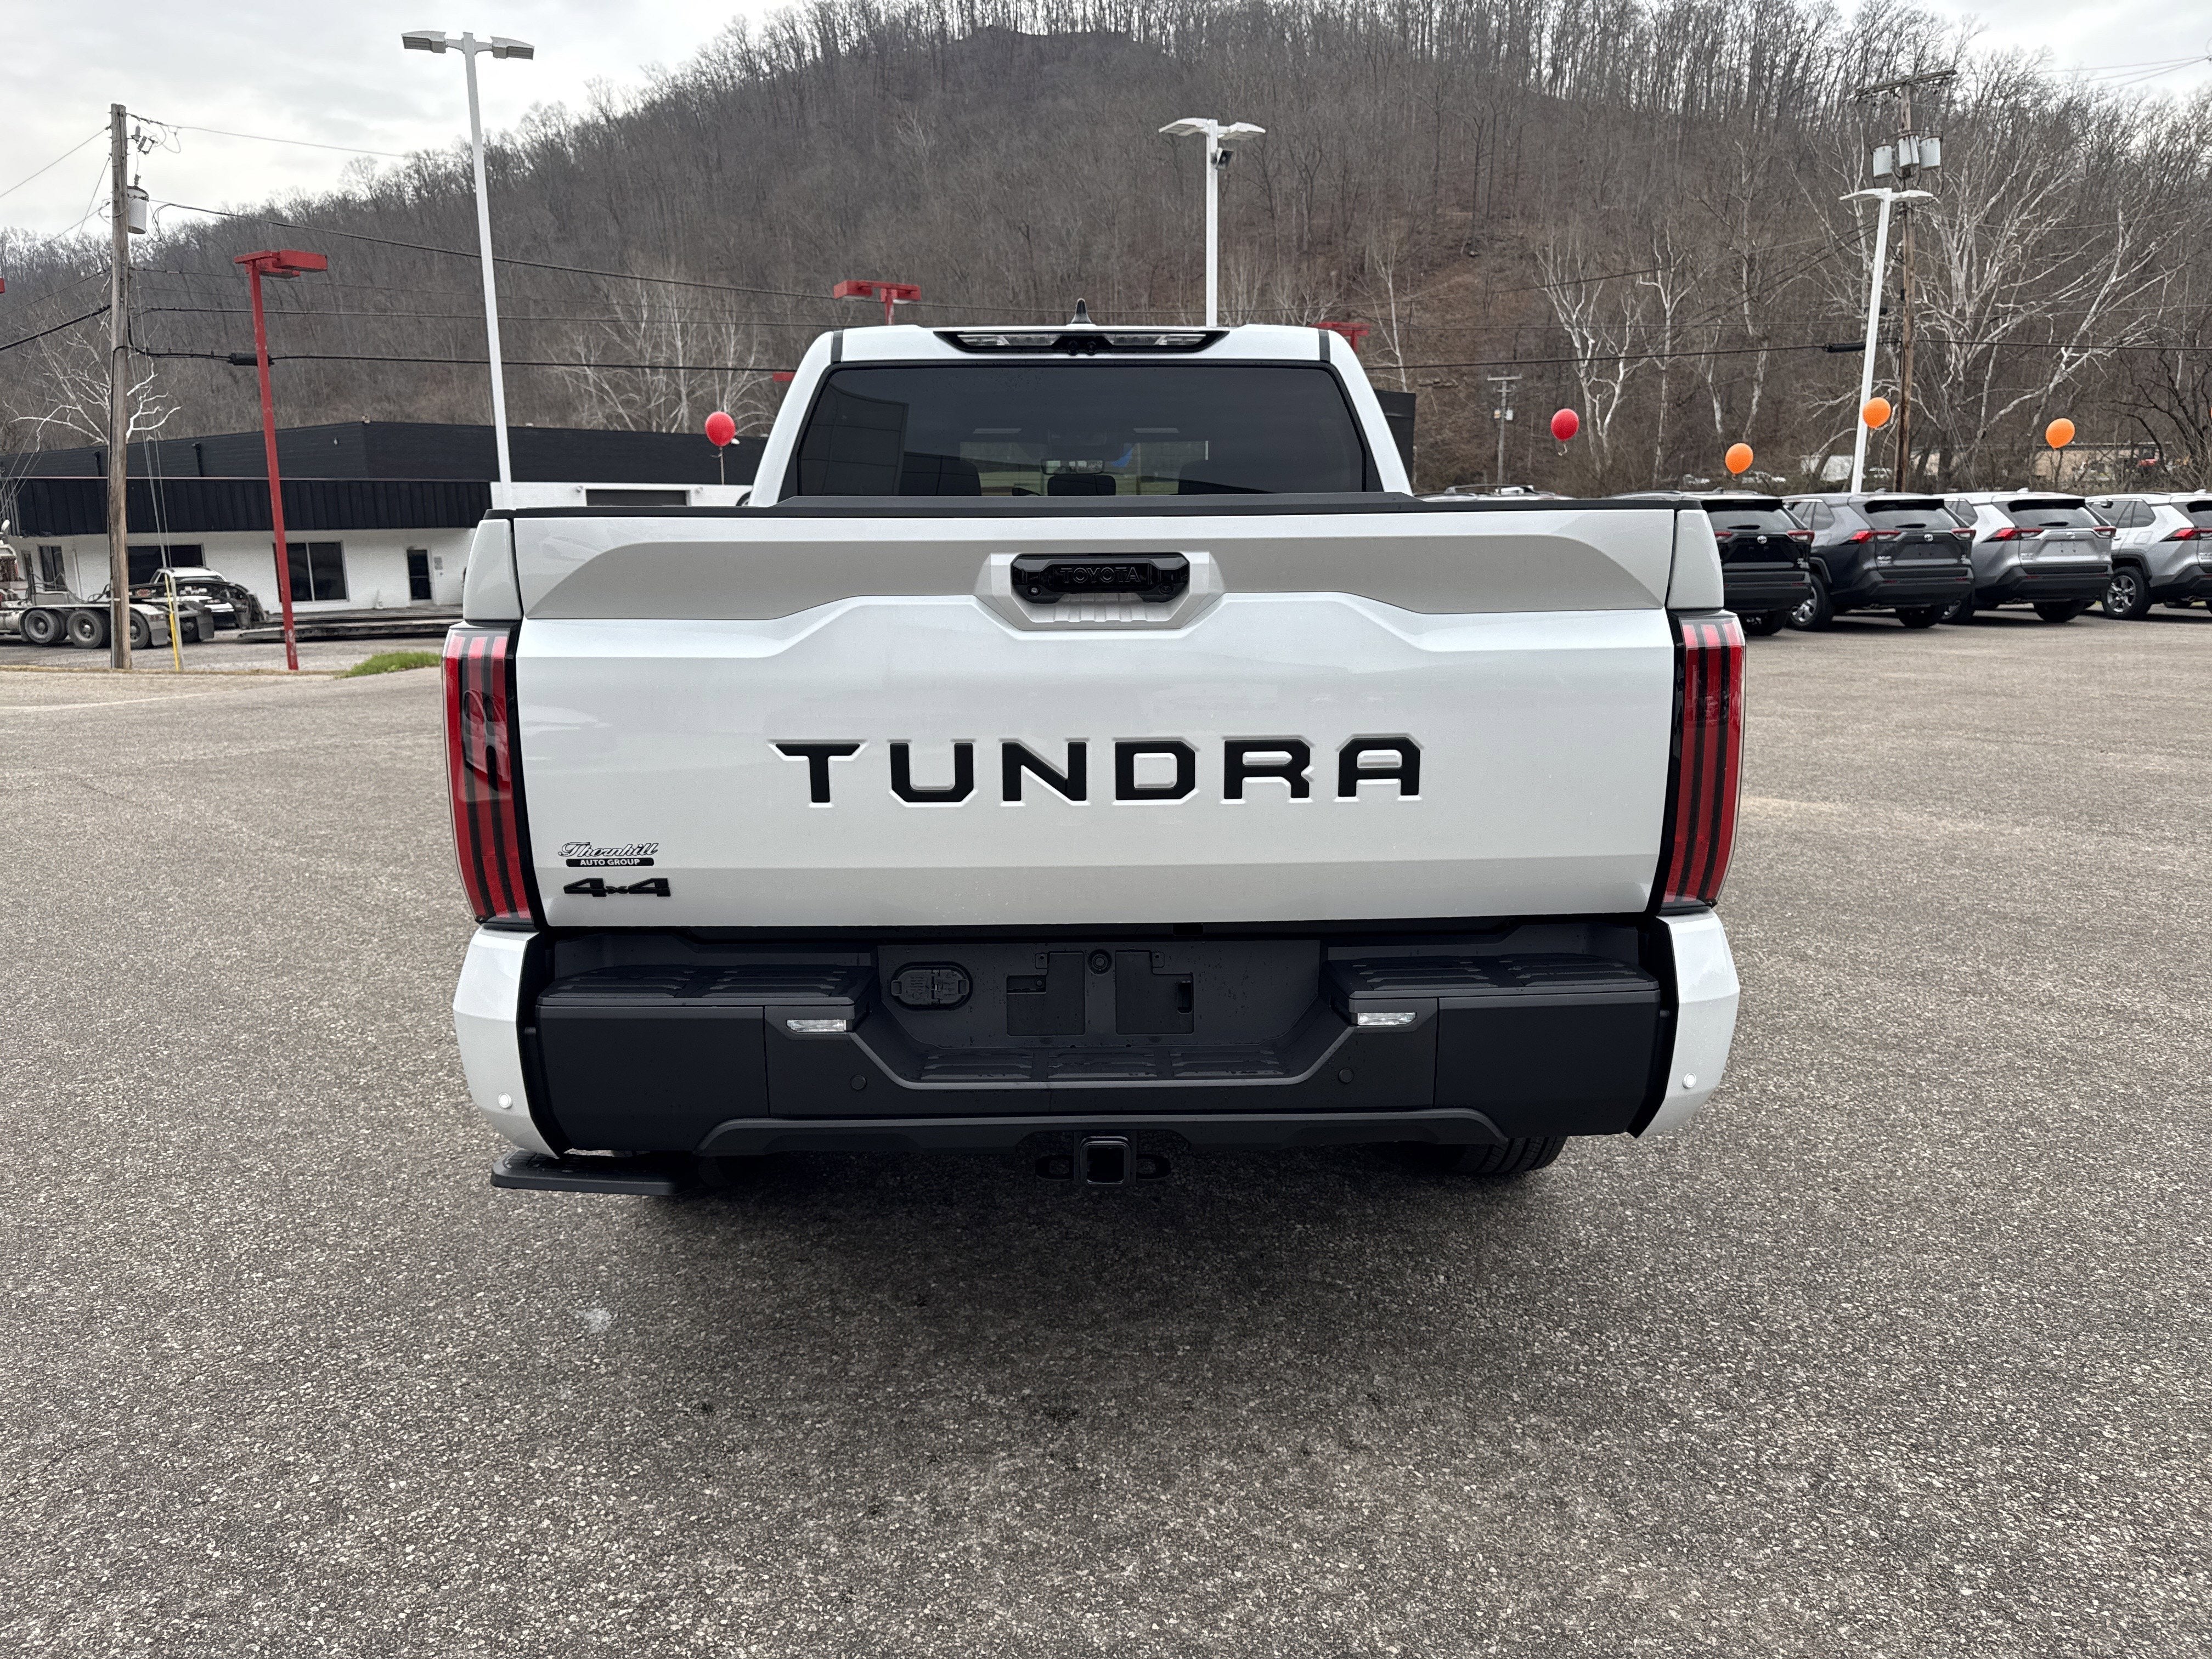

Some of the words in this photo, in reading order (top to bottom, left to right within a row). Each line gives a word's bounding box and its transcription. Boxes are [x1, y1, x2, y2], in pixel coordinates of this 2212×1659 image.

[1060, 567, 1141, 584] TOYOTA
[770, 736, 1423, 806] TUNDRA
[557, 842, 659, 857] Thornhill
